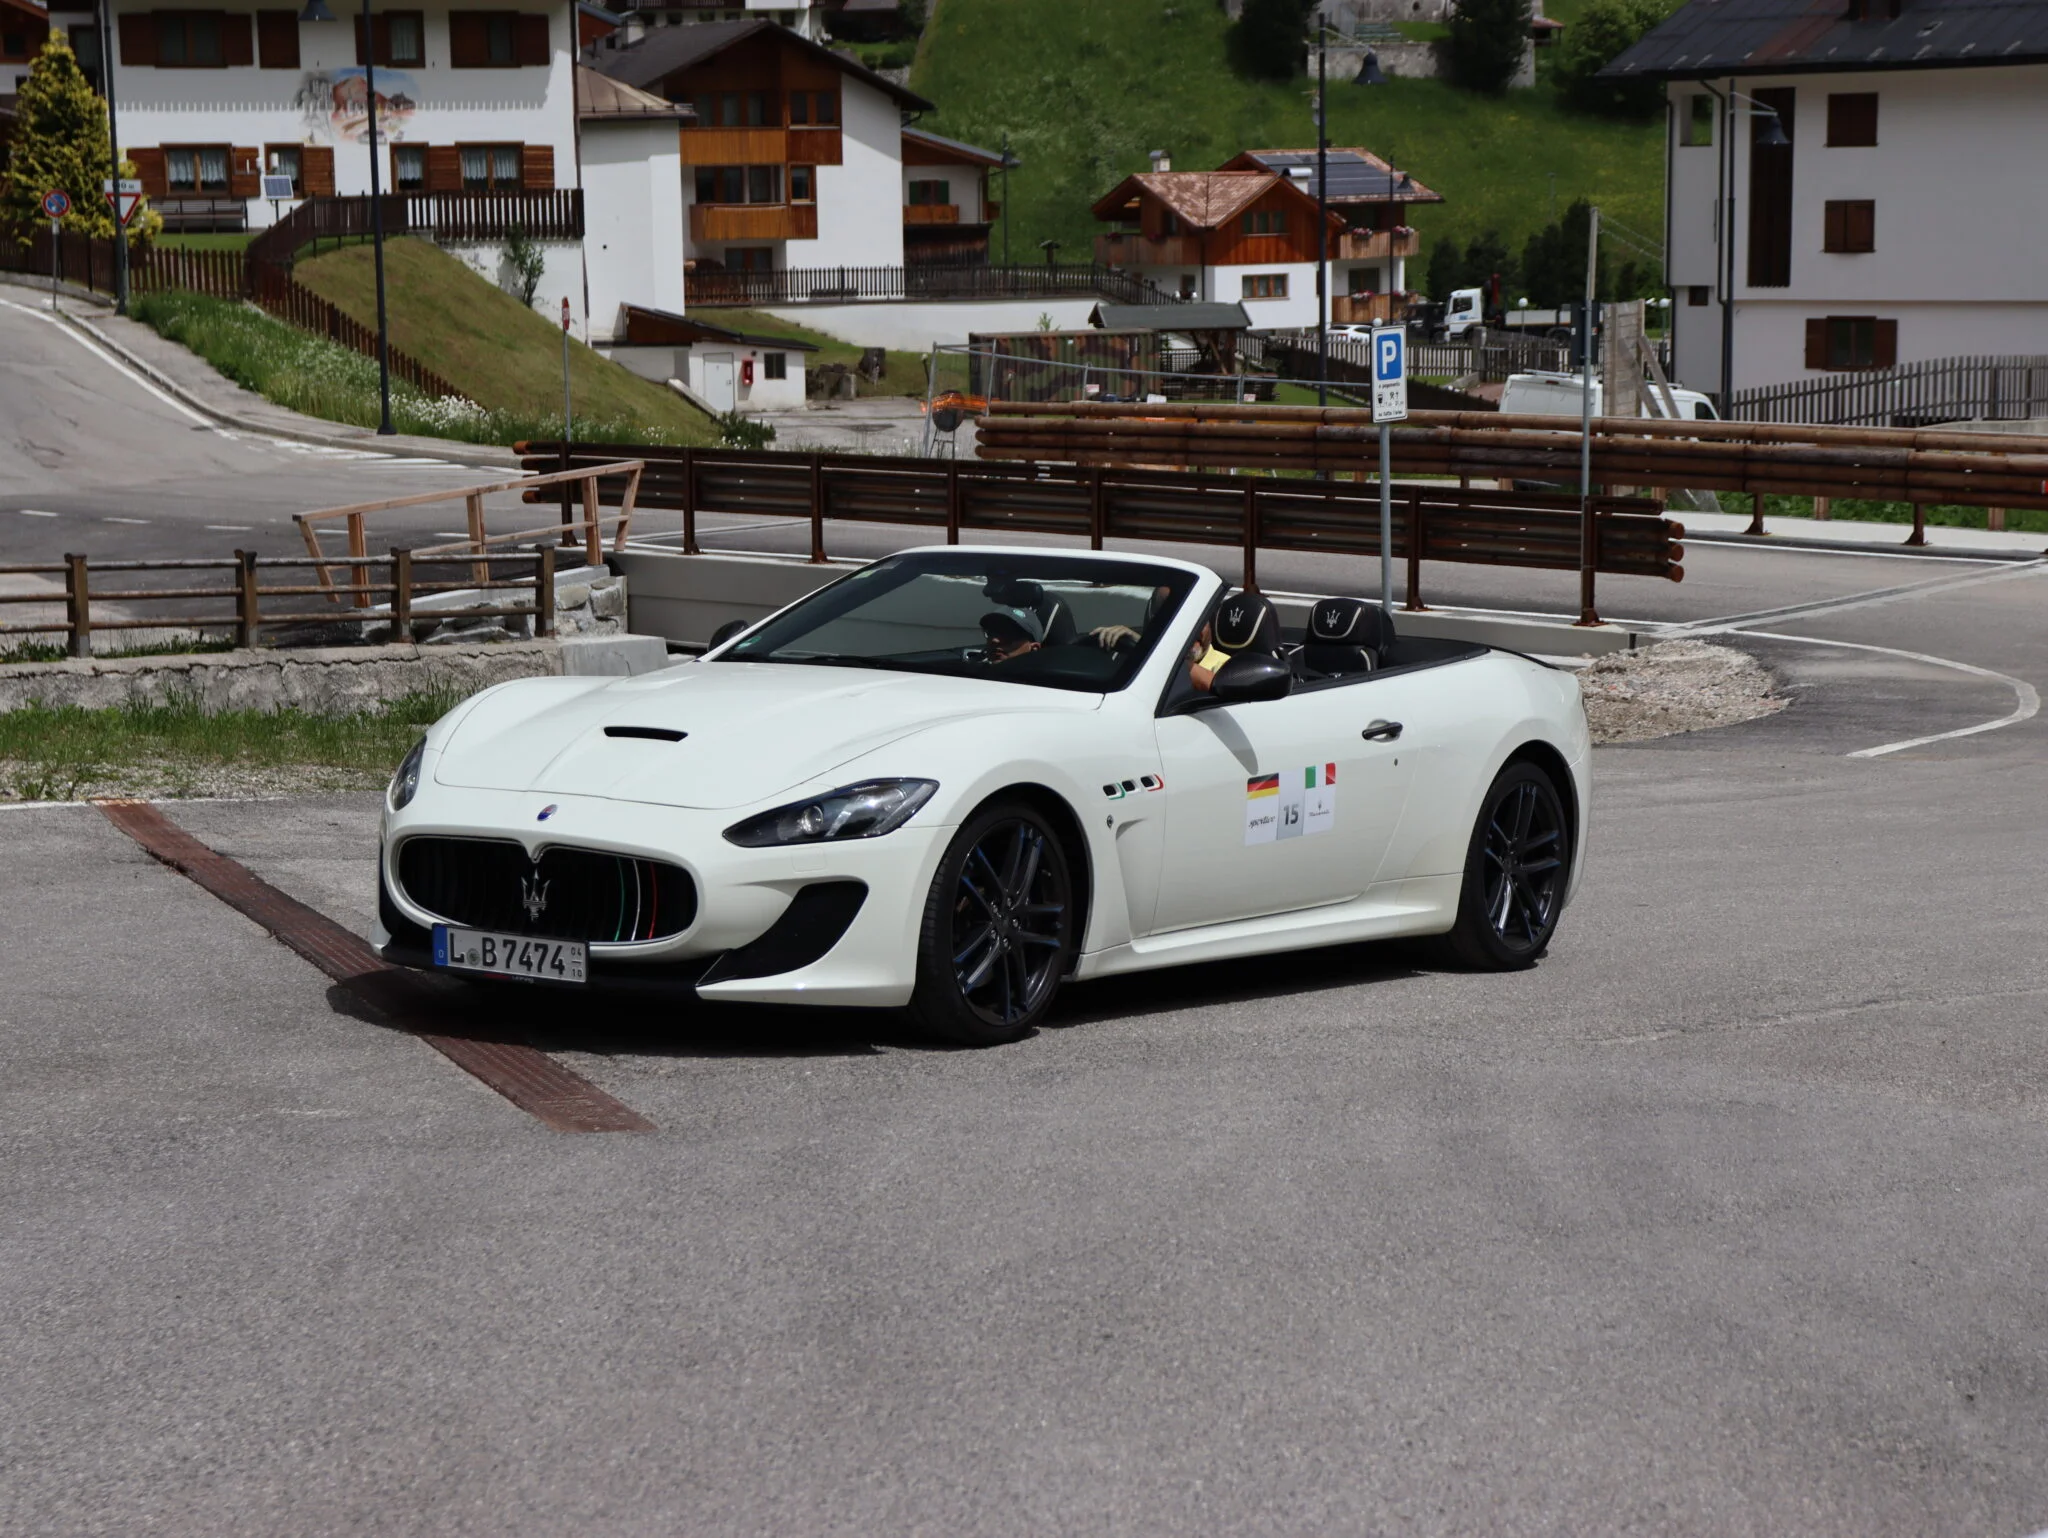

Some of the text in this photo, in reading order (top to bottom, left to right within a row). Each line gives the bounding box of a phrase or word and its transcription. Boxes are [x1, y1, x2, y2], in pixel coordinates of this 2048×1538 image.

[1382, 340, 1397, 375] P
[1283, 803, 1299, 826] 15
[449, 932, 465, 964] L
[570, 946, 582, 957] 04
[571, 969, 583, 978] 10
